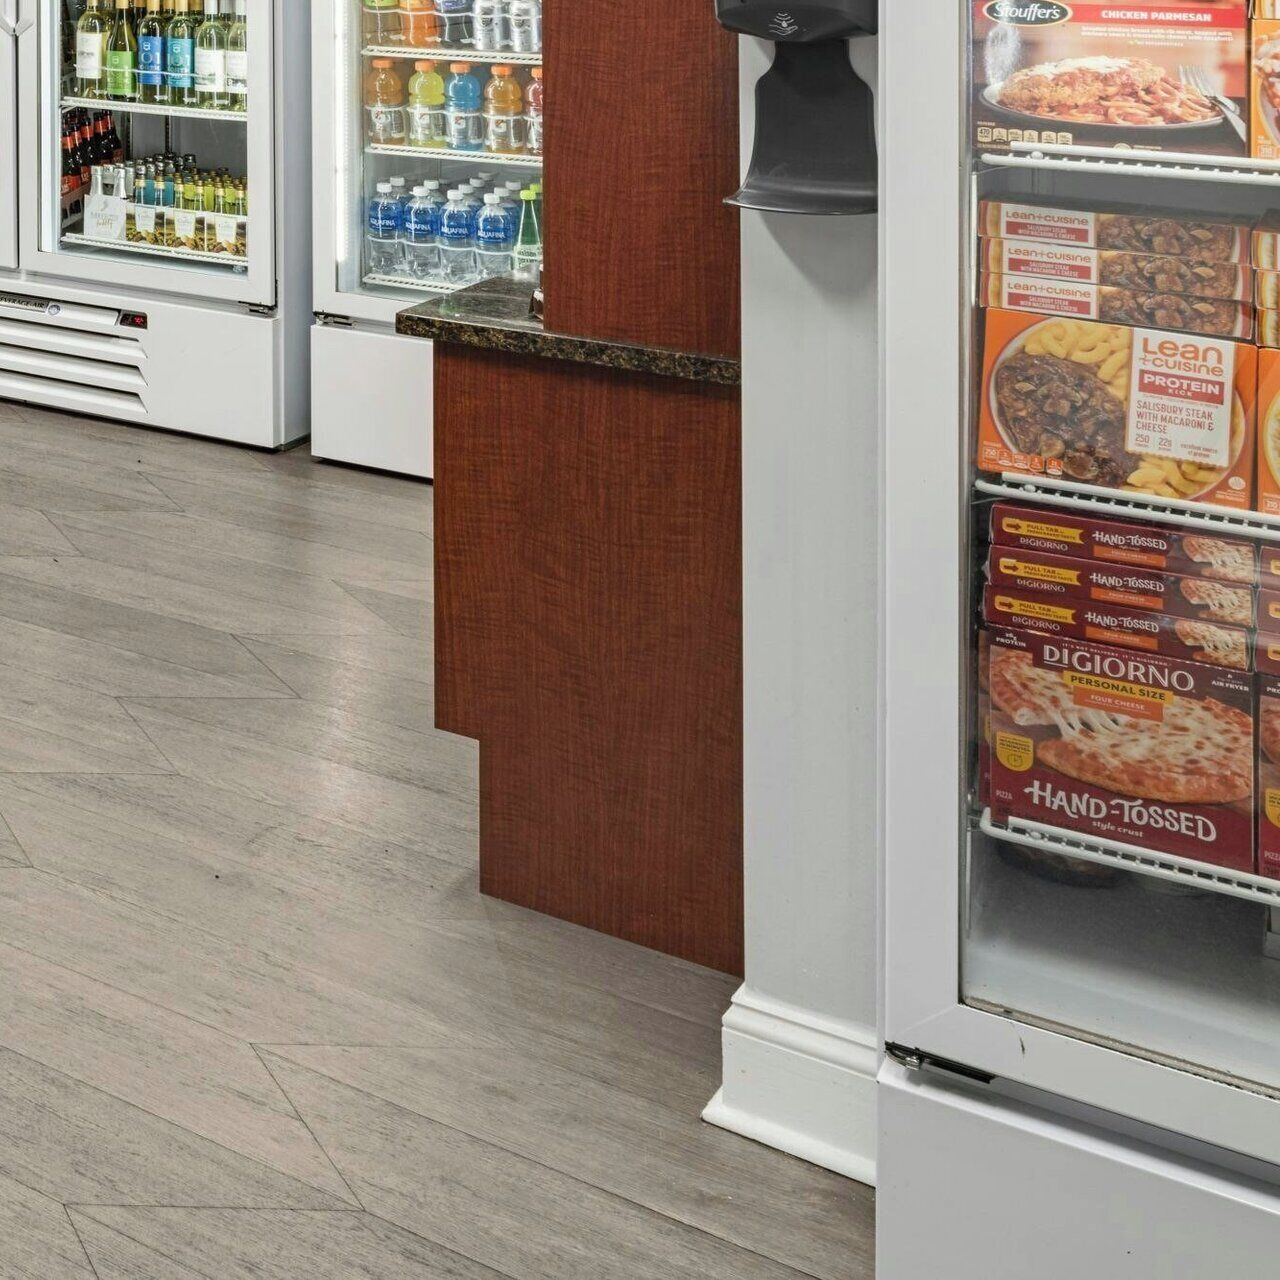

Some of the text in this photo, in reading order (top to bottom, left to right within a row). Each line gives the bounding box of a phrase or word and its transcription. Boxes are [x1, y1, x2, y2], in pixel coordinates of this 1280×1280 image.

[993, 0, 1061, 21] Stouffer's
[1101, 9, 1212, 22] CHICKEN PARMESAN
[370, 218, 396, 227] AQUAFINA
[405, 221, 431, 231] AQUAFINA
[441, 226, 468, 235] AQUAFINA
[477, 230, 505, 239] AQUAFINA
[1142, 337, 1224, 366] Lean
[1143, 373, 1220, 395] PROTEIN
[1136, 400, 1183, 416] SALISBURY
[1185, 407, 1214, 420] STEAK
[1136, 410, 1158, 421] WITH
[1160, 414, 1206, 430] MACARONI
[1136, 422, 1168, 434] CHEESE
[1135, 433, 1150, 444] 250
[1092, 531, 1168, 551] HAND-TOSSED
[1089, 572, 1165, 593] HAND-TOSSED
[1084, 611, 1160, 633] HAND-TOSSED
[995, 637, 1026, 647] PROTEIN
[1070, 675, 1166, 701] PERSONAL SIZE
[1225, 682, 1250, 692] FRYER
[1090, 694, 1145, 711] FOUR CHEESE
[996, 789, 1013, 800] PIZZA
[1023, 780, 1217, 842] HAND-TOSSED
[1092, 819, 1144, 838] style crust
